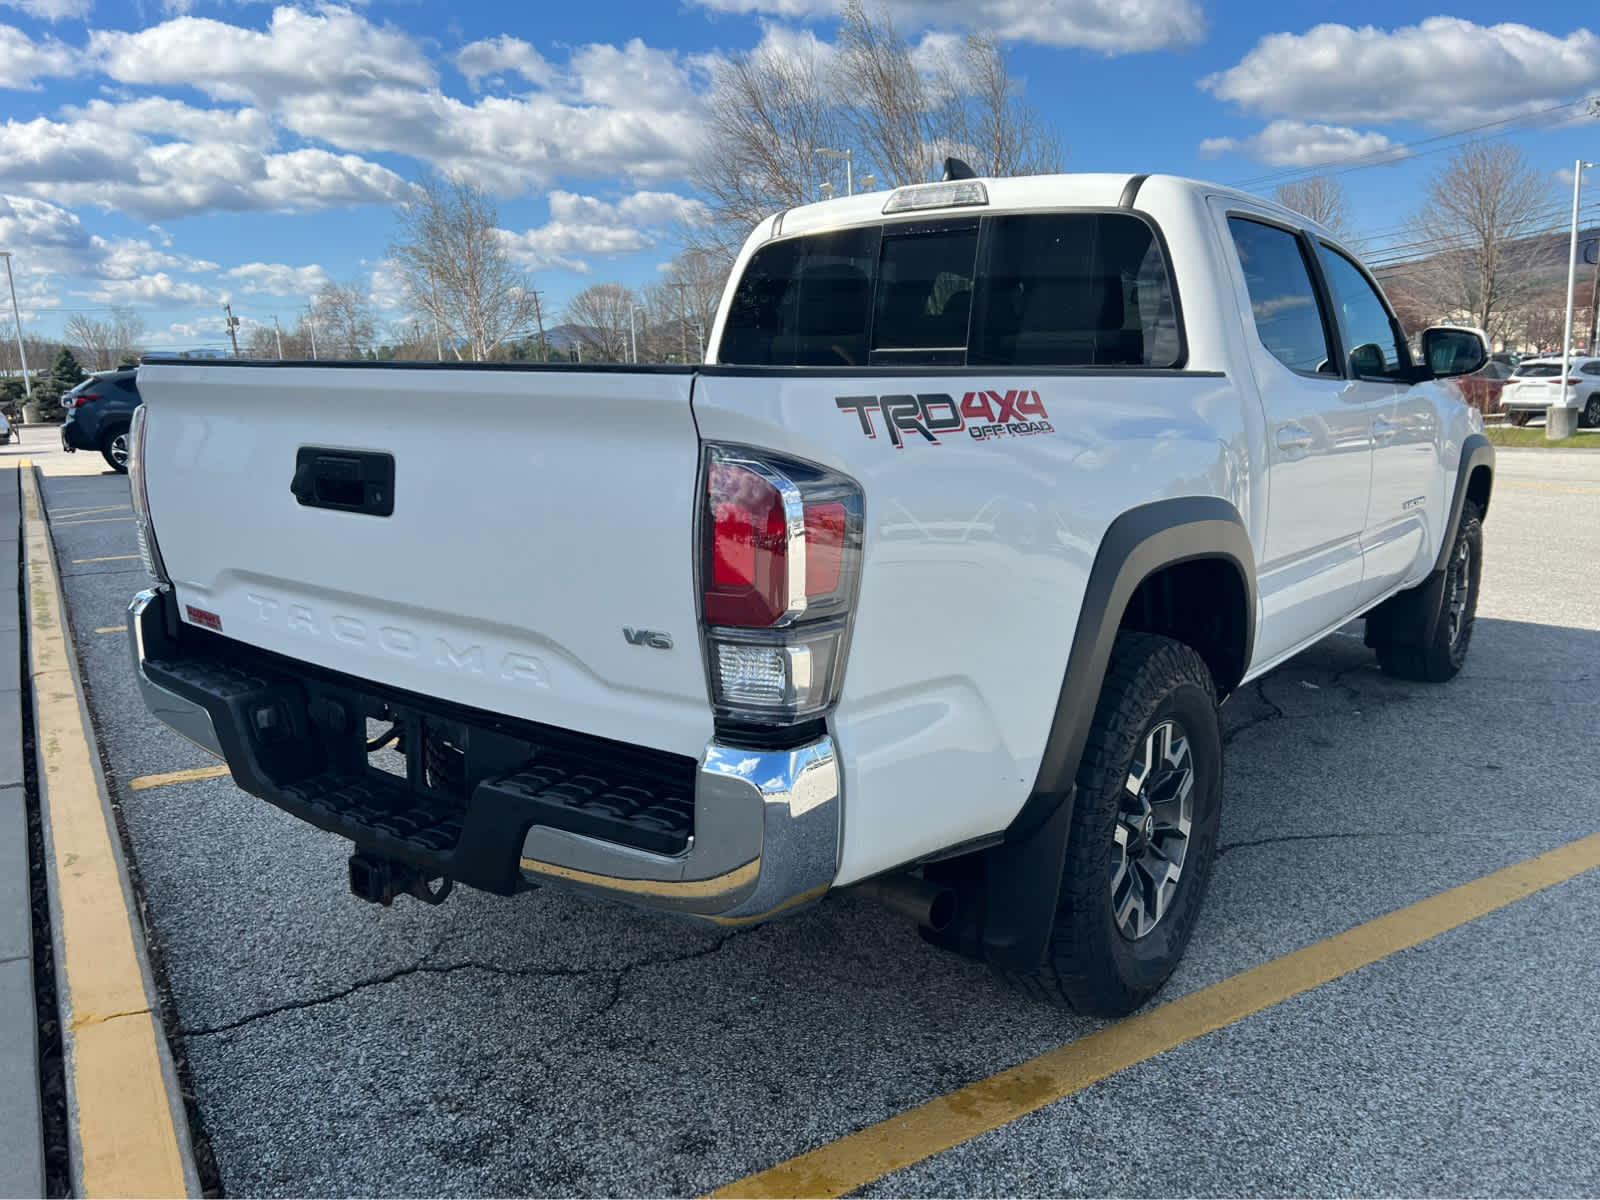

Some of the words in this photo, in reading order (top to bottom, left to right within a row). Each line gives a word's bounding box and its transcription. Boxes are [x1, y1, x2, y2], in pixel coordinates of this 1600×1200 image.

[835, 393, 965, 448] TRD
[247, 592, 552, 688] TACOMA
[622, 624, 674, 649] V6
